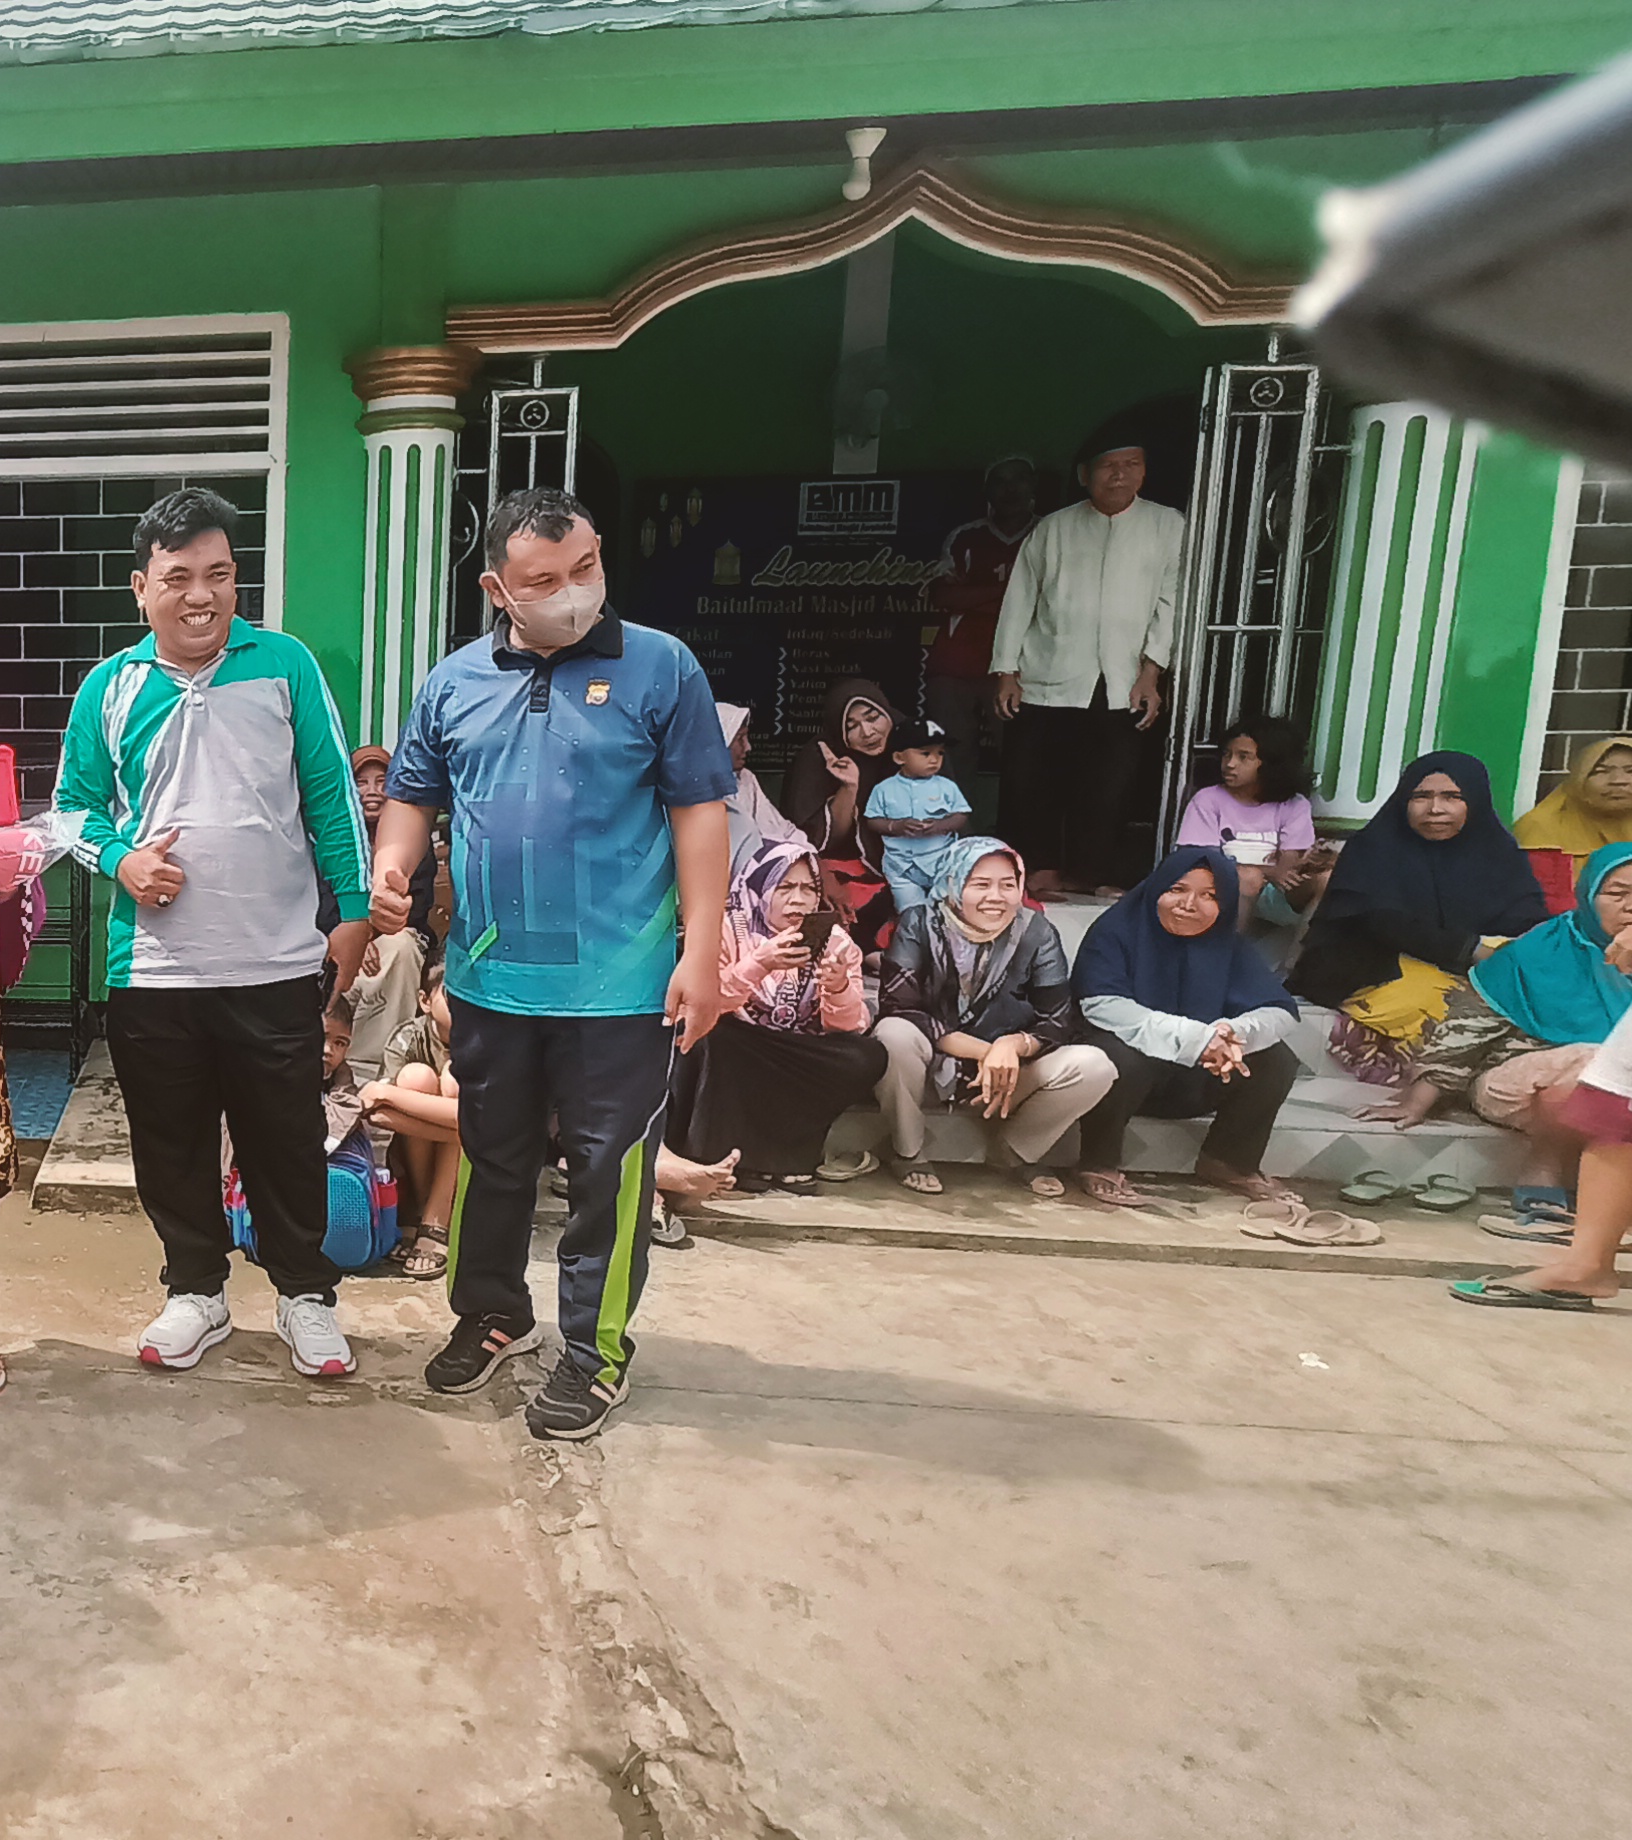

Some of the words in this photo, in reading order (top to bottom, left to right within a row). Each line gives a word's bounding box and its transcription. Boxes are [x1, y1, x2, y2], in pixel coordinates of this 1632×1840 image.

[750, 544, 942, 597] Launching
[696, 595, 803, 615] Baitulmaal
[811, 595, 876, 617] Masjid
[674, 627, 720, 642] akat
[926, 720, 945, 736] A
